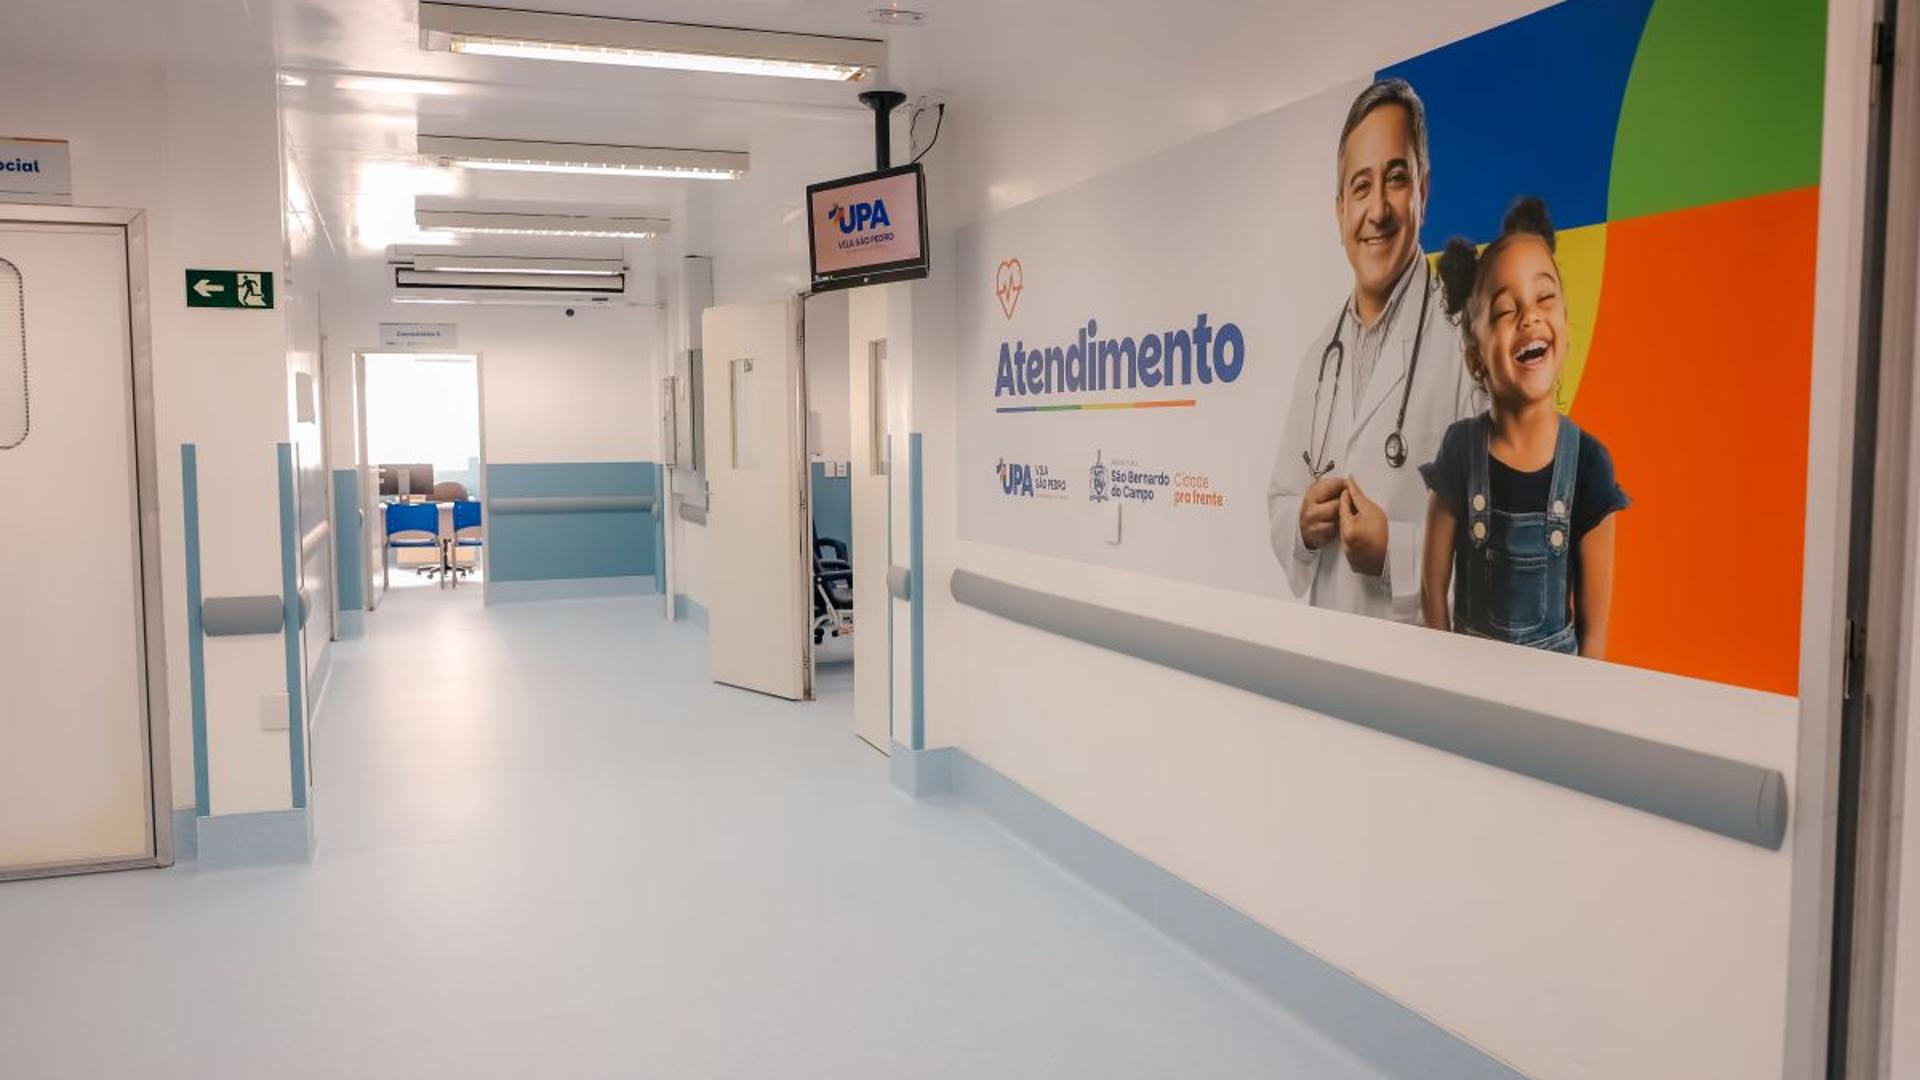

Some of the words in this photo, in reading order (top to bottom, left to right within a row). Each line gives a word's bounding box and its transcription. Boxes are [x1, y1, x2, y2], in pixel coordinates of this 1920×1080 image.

[839, 198, 891, 234] UPA
[994, 313, 1245, 397] Atendimento
[1003, 463, 1034, 497] UPA
[1111, 470, 1127, 483] São
[1128, 470, 1170, 486] Bernardo
[1174, 471, 1209, 489] Cidade
[1111, 485, 1122, 497] do
[1122, 485, 1154, 502] Campo
[1174, 491, 1191, 506] pro
[1193, 489, 1224, 507] frente
